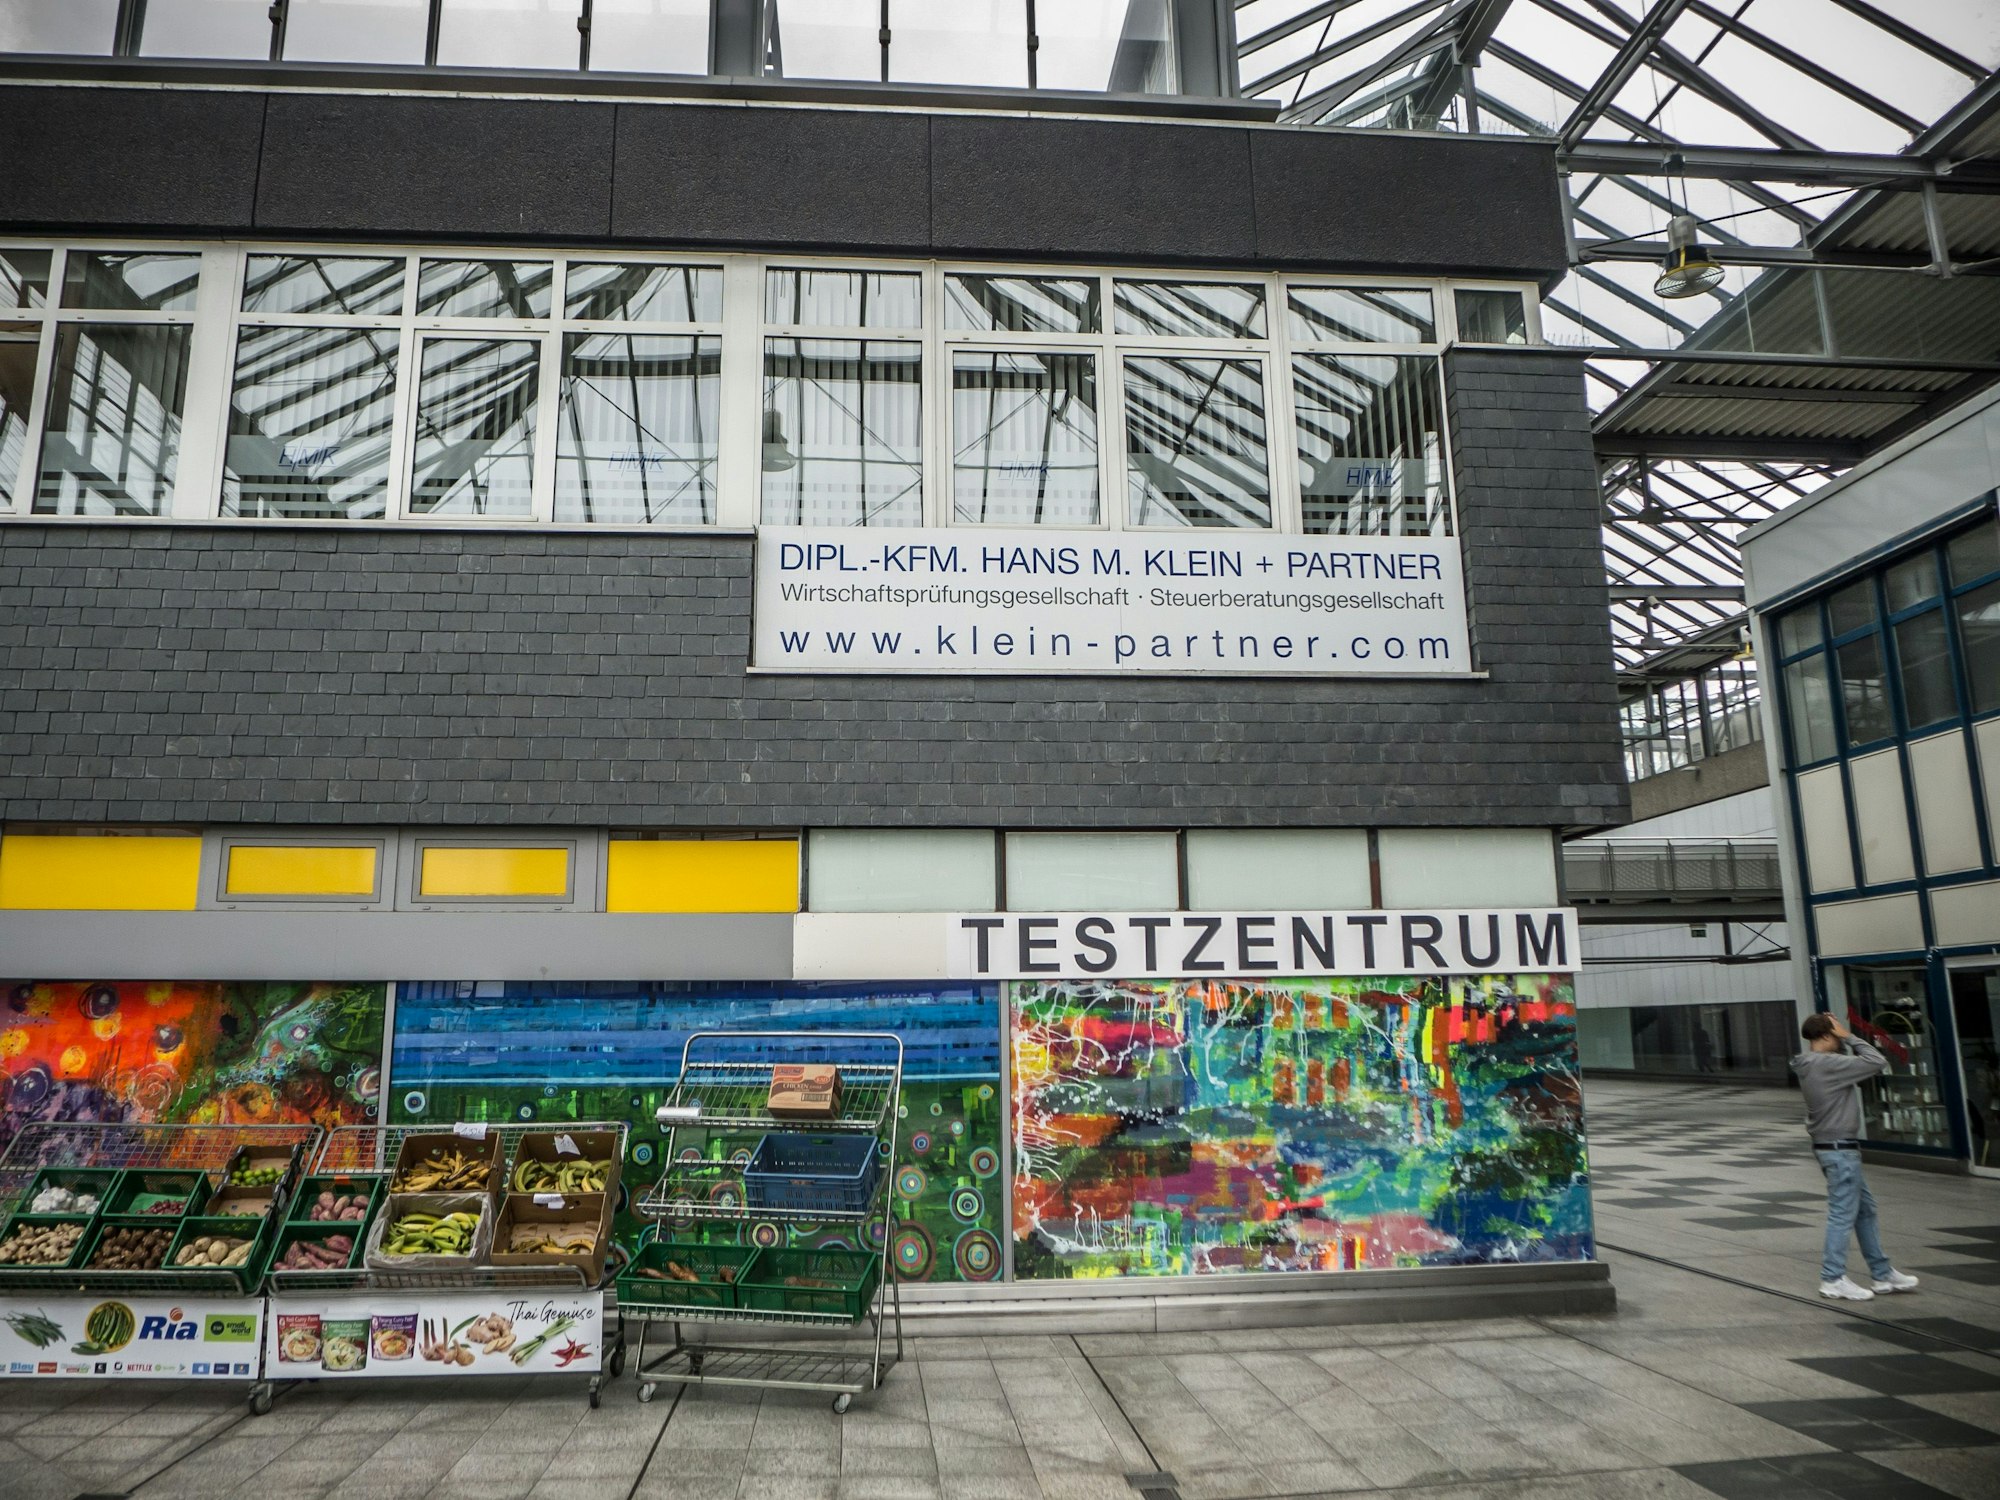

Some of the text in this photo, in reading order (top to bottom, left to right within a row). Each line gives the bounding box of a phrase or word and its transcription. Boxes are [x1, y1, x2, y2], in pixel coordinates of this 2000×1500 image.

[780, 543, 1442, 580] DIPL.-KFM. HANS M. KLEIN + PARTNER
[780, 583, 1130, 609] Wirtschaftsprüfungsgesellschaft
[1150, 587, 1445, 613] Steuerberatungsgesellschaft
[779, 625, 1450, 665] www.klein-partner.com
[961, 913, 1568, 973] TESTZENTRUM
[138, 1306, 198, 1341] Ria
[226, 1320, 246, 1330] small
[506, 1299, 597, 1327] Thai Gemüse
[231, 1326, 252, 1335] world
[127, 1363, 153, 1372] NETFLIX
